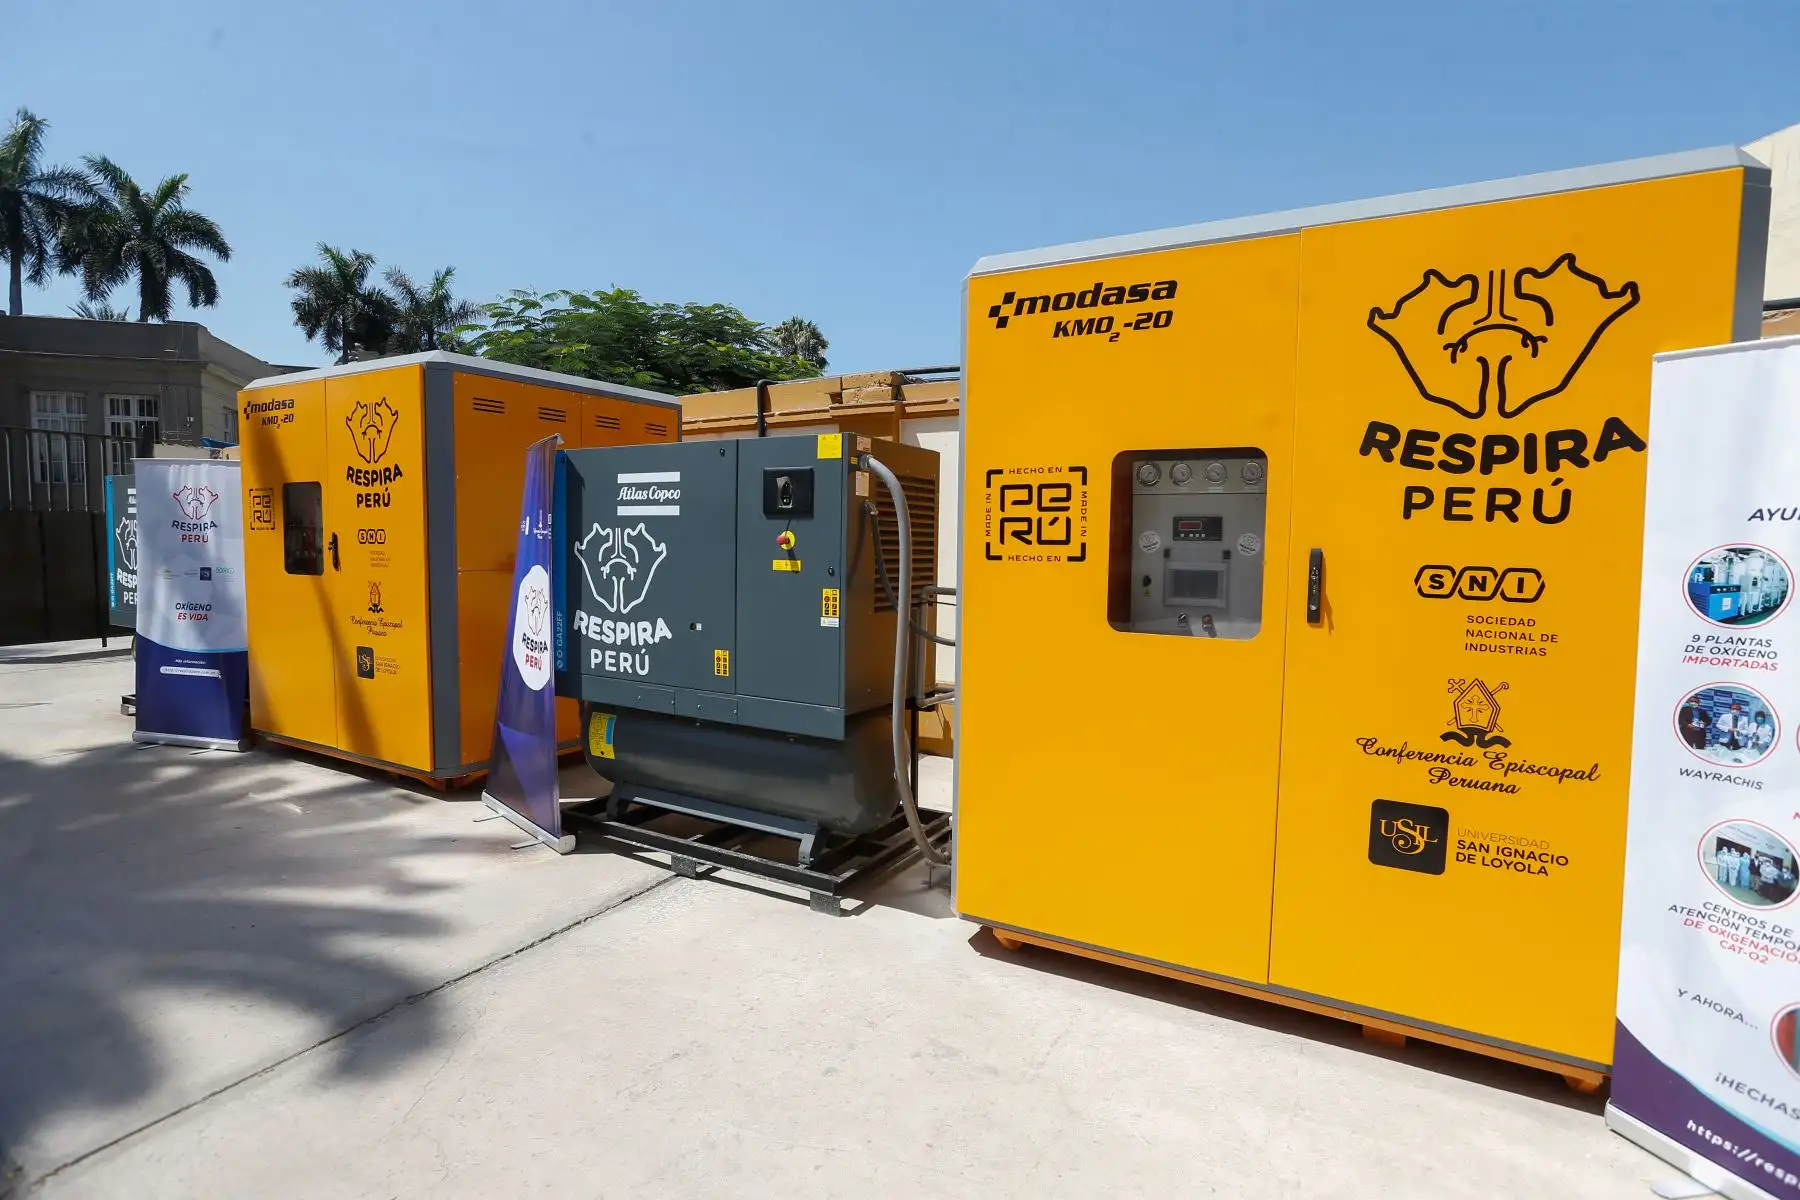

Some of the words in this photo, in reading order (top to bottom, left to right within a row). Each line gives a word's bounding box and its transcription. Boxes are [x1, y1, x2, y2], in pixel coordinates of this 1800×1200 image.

[1013, 279, 1178, 316] modasa
[251, 399, 294, 414] modasa
[1359, 416, 1647, 475] RESPIRA
[346, 464, 403, 487] RESPIRA
[1008, 467, 1045, 475] HECHO
[1047, 466, 1063, 474] EN
[357, 487, 390, 508] PERÚ
[616, 486, 648, 501] Atlas
[648, 485, 681, 503] Copco
[985, 493, 992, 504] IN
[1402, 477, 1572, 524] PERÚ
[1080, 490, 1088, 523] MADE
[1747, 507, 1800, 521] AYU
[171, 520, 218, 532] RESPIRA
[1080, 526, 1088, 537] IN
[181, 532, 209, 543] PERÚ
[116, 567, 138, 590] RESP
[175, 602, 212, 612] OXÍGENO
[177, 612, 187, 621] ES
[189, 612, 209, 621] VIDA
[1466, 615, 1536, 627] SOCIEDAD
[573, 609, 672, 647] RESPIRA
[1465, 629, 1536, 642] NACIONAL
[1540, 633, 1559, 643] DE
[521, 632, 549, 654] RESPIRA
[1464, 642, 1548, 657] INDUSTRIAS
[1692, 634, 1701, 643] 9
[1705, 635, 1772, 648] PLANTAS
[1684, 644, 1705, 654] DE
[1709, 645, 1778, 660] OXÍGENO
[525, 653, 543, 671] PERÚ
[590, 648, 650, 676] PERÚ
[1682, 655, 1779, 671] IMPORTADAS
[1356, 737, 1479, 767] Conferencia
[1483, 751, 1602, 784] Episcopal
[1428, 767, 1522, 795] Peruana
[1679, 767, 1763, 790] WAYRACHIS
[1457, 828, 1550, 850] UNIVERSIDAD
[1457, 839, 1490, 853] SAN
[1496, 845, 1569, 866] IGNACIO
[1455, 852, 1477, 865] DE
[1482, 856, 1549, 877] LOYOLA
[1683, 918, 1705, 929] DE
[1702, 901, 1767, 929] CENTROS
[1771, 924, 1794, 938] DE
[1678, 988, 1688, 998] Y
